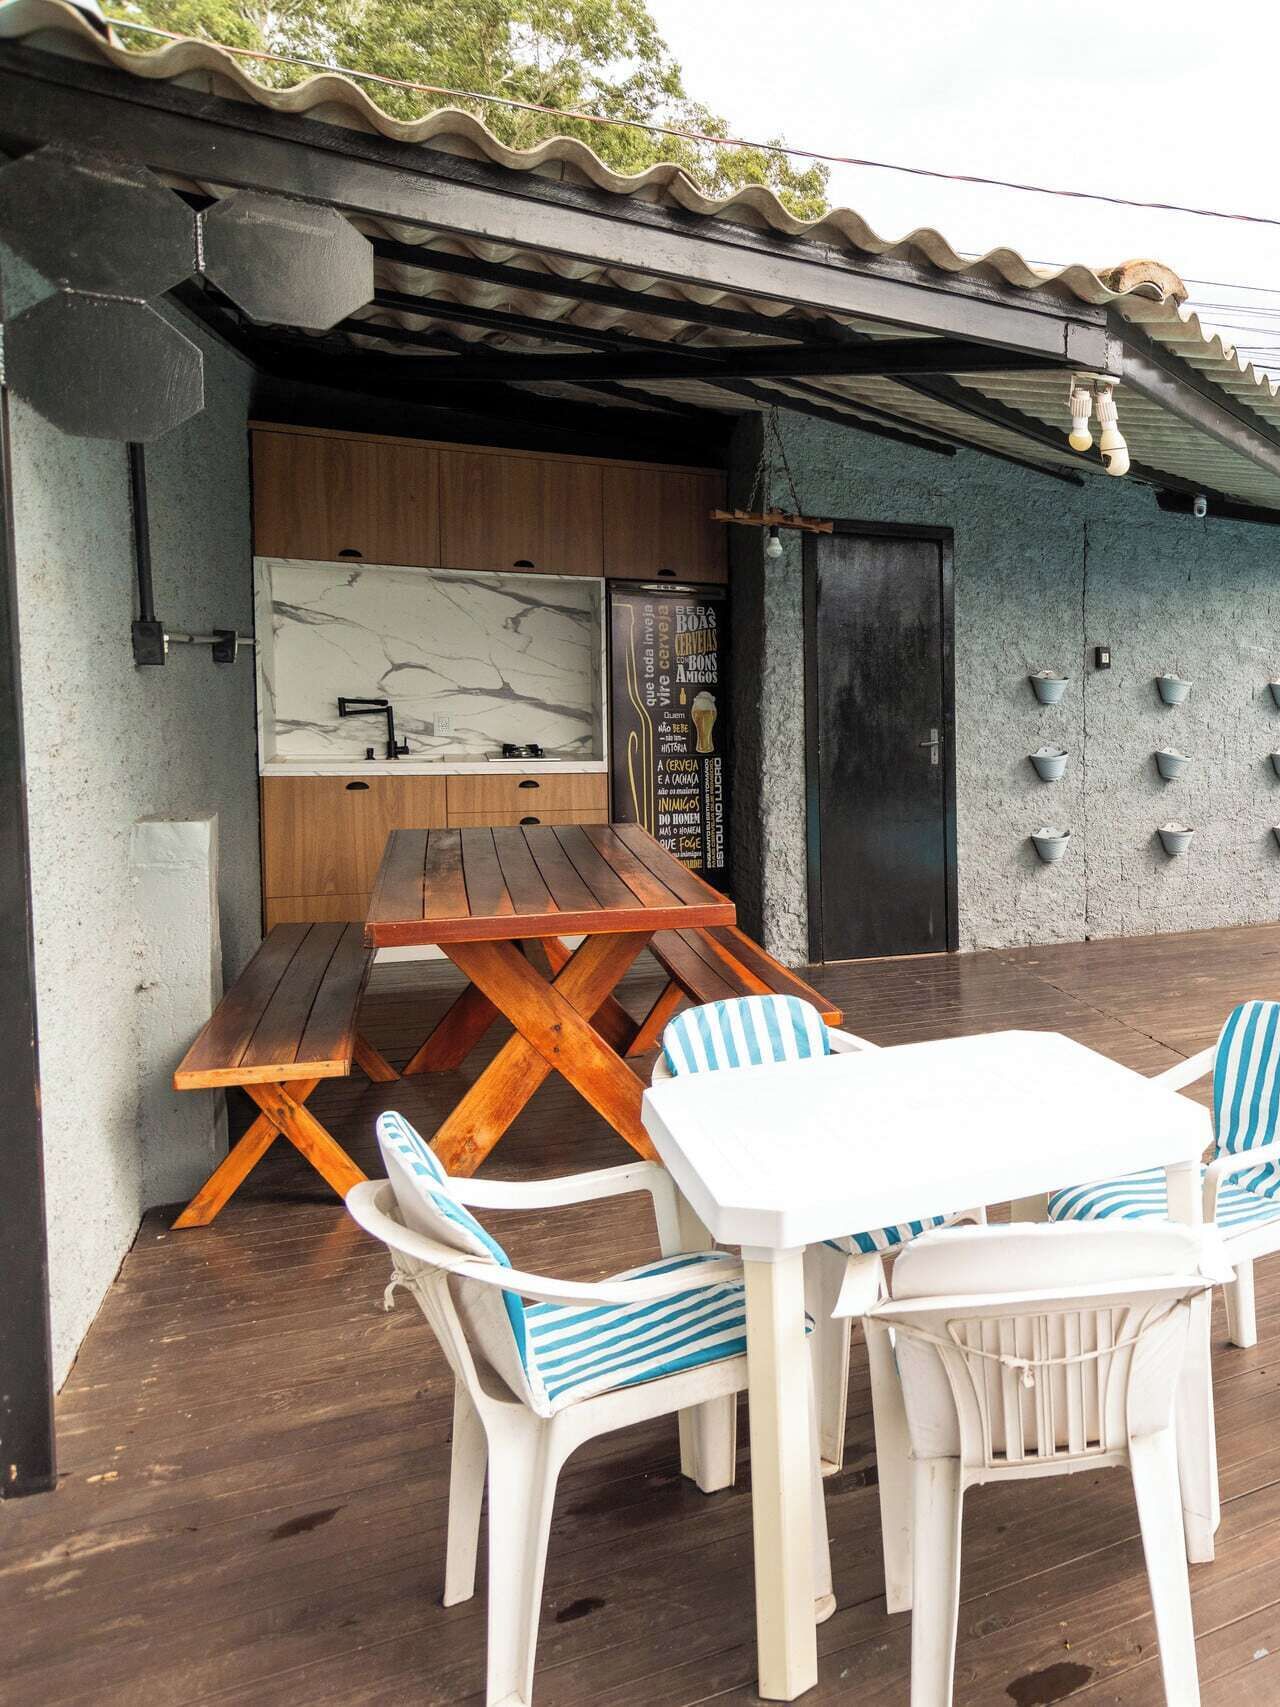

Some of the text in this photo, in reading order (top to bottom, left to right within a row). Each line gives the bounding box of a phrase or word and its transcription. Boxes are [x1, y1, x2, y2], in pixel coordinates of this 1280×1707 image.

[676, 607, 715, 616] BEBA
[676, 614, 717, 633] BOAS
[657, 605, 671, 670] cerveja
[675, 629, 718, 656] CERVEJAS
[643, 604, 656, 706] que toda inveja
[688, 652, 718, 671] BONS
[676, 664, 718, 683] AMIGOS
[657, 675, 671, 706] vire
[663, 711, 686, 719] Quem
[672, 723, 689, 733] BEBE
[657, 758, 699, 773] A CERVEJA
[664, 774, 670, 785] A
[671, 772, 699, 787] CACHAÇA
[658, 796, 700, 813] INIMIGOS
[714, 757, 724, 868] ESTOU NO LUCRO
[658, 812, 701, 826] DO HOMEM
[658, 826, 671, 836] MAS
[679, 825, 701, 835] HOMEM
[680, 836, 702, 851] FOGE
